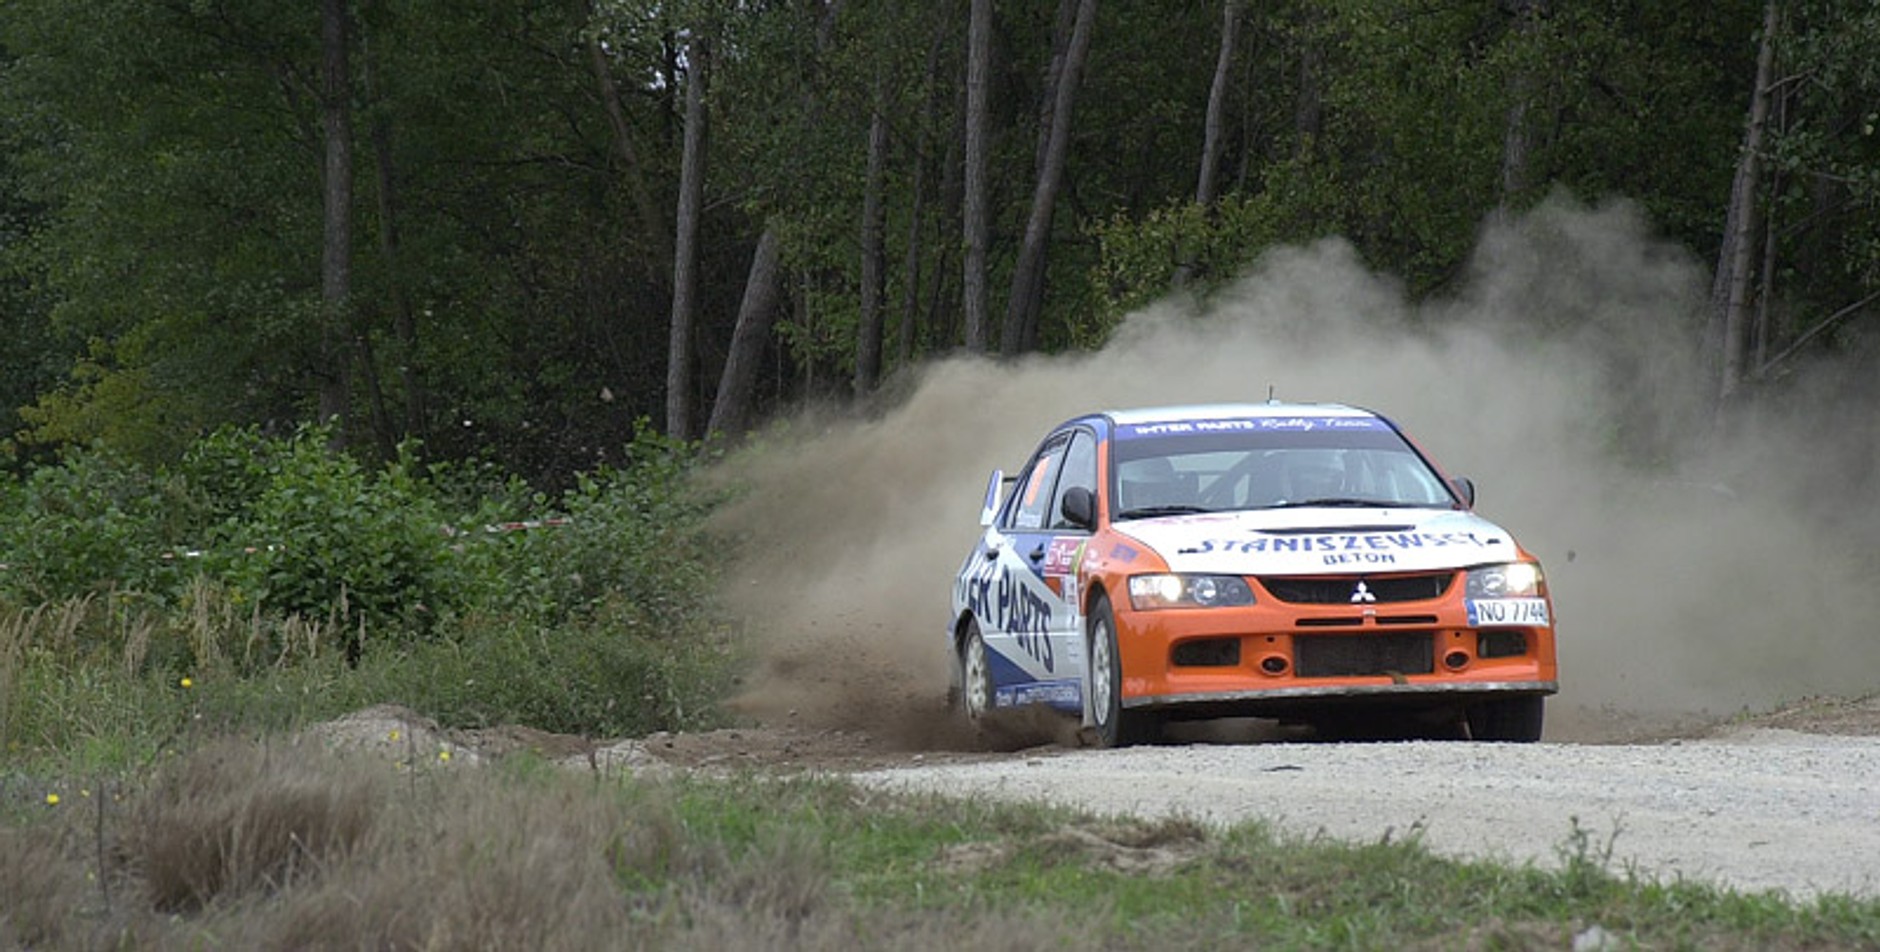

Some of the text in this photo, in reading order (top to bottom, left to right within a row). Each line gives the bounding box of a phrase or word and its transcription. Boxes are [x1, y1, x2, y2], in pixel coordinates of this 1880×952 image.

[1135, 417, 1373, 434] INTER PARTS Rally Team
[1322, 552, 1396, 566] BETON
[997, 563, 1054, 674] PARTS
[1478, 601, 1506, 622] NO
